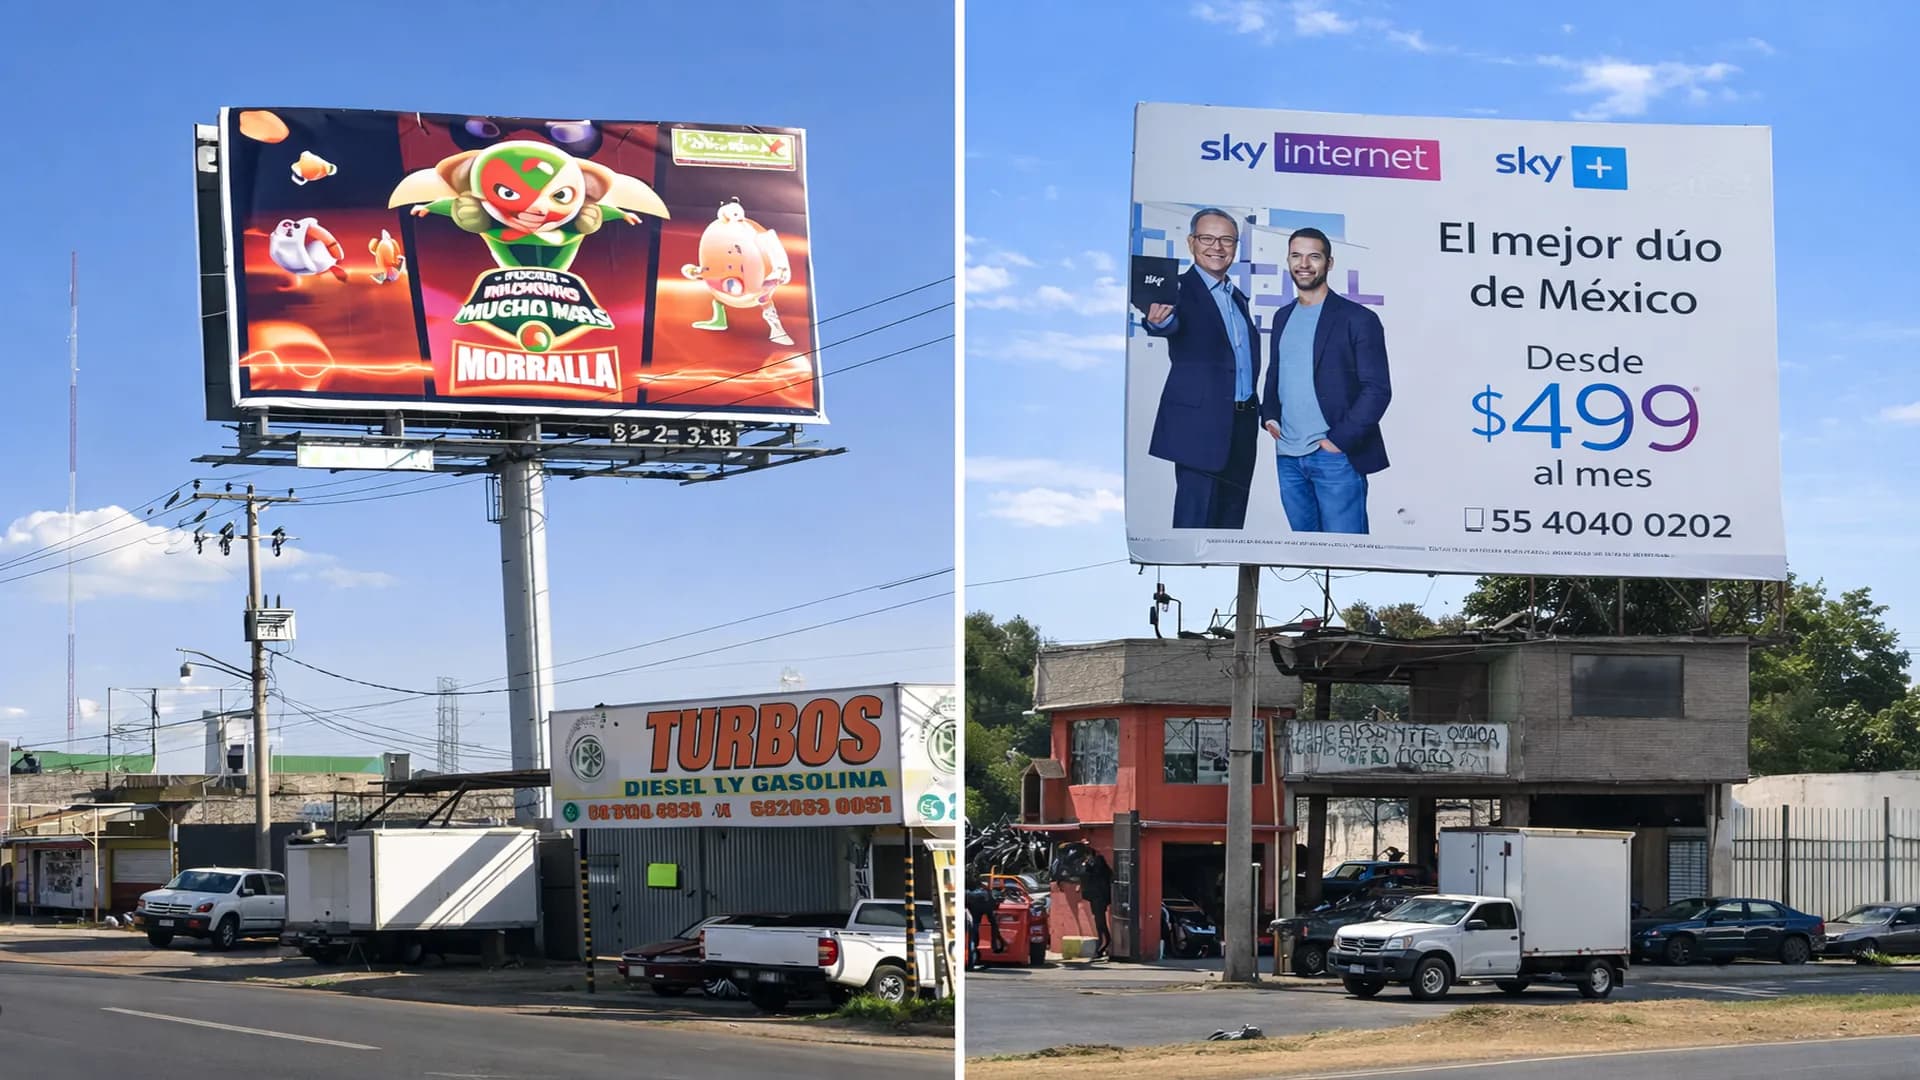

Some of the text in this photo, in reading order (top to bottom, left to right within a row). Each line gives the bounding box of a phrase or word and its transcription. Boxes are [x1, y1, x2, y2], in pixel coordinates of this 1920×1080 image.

[1200, 133, 1430, 172] sky internet
[1495, 145, 1563, 183] sky
[1439, 221, 1722, 266] El mejor dúo
[461, 299, 549, 322] MUCHO
[1470, 275, 1698, 315] de México
[457, 345, 618, 389] MORRALLA
[1527, 345, 1643, 374] Desde
[1471, 382, 1700, 452] $499
[1533, 459, 1653, 488] al mes
[1491, 509, 1733, 538] 55 4040 0202
[646, 694, 884, 774] TURBOS
[624, 778, 707, 797] DIESEL
[751, 770, 887, 793] GASOLINA
